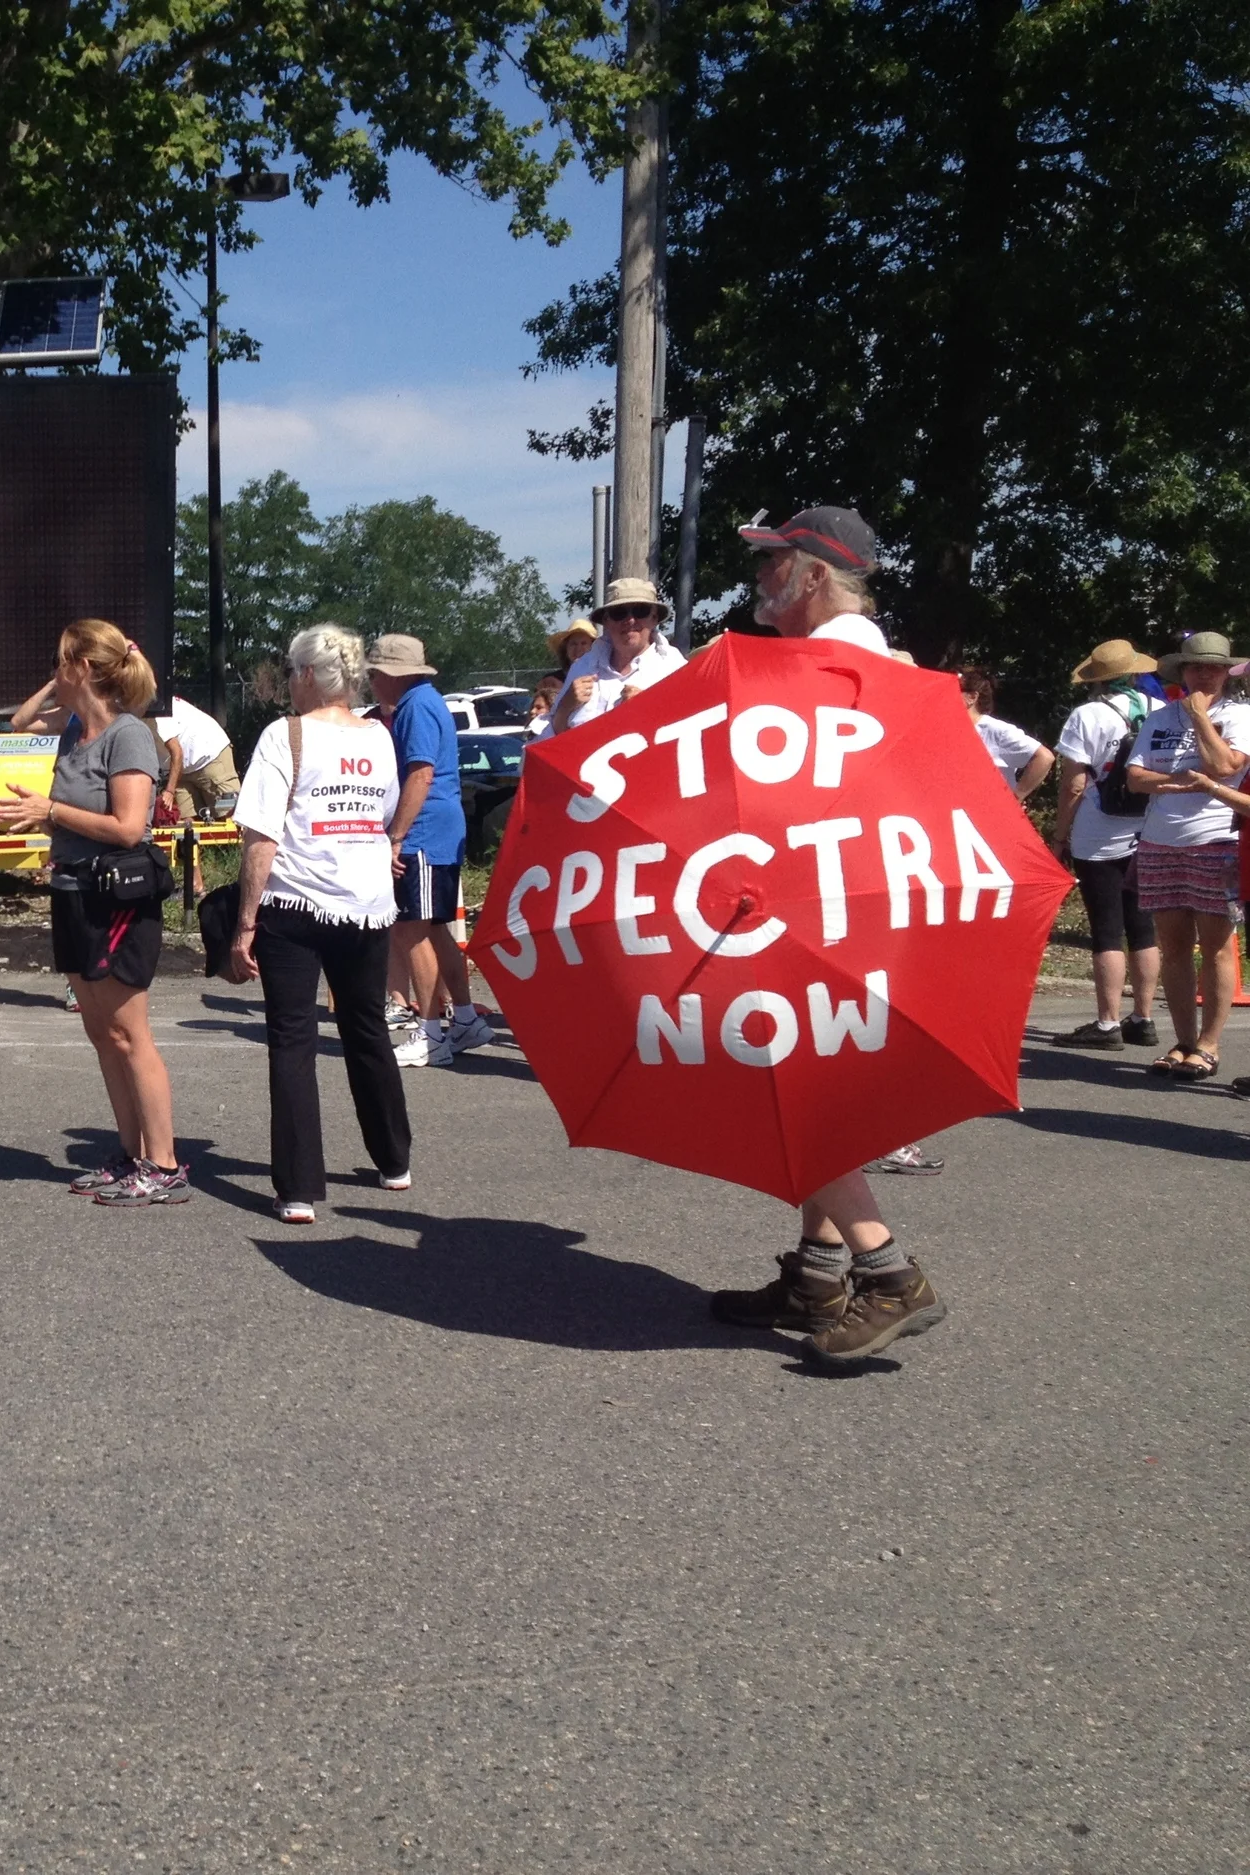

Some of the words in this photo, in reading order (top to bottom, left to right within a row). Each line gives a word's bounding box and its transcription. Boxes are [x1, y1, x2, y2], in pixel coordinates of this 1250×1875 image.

[0, 737, 57, 748] massDOT
[340, 757, 373, 777] NO
[565, 702, 884, 823] STOP
[323, 823, 350, 832] South
[491, 809, 1014, 981] SPECTRA
[635, 969, 890, 1067] NOW
